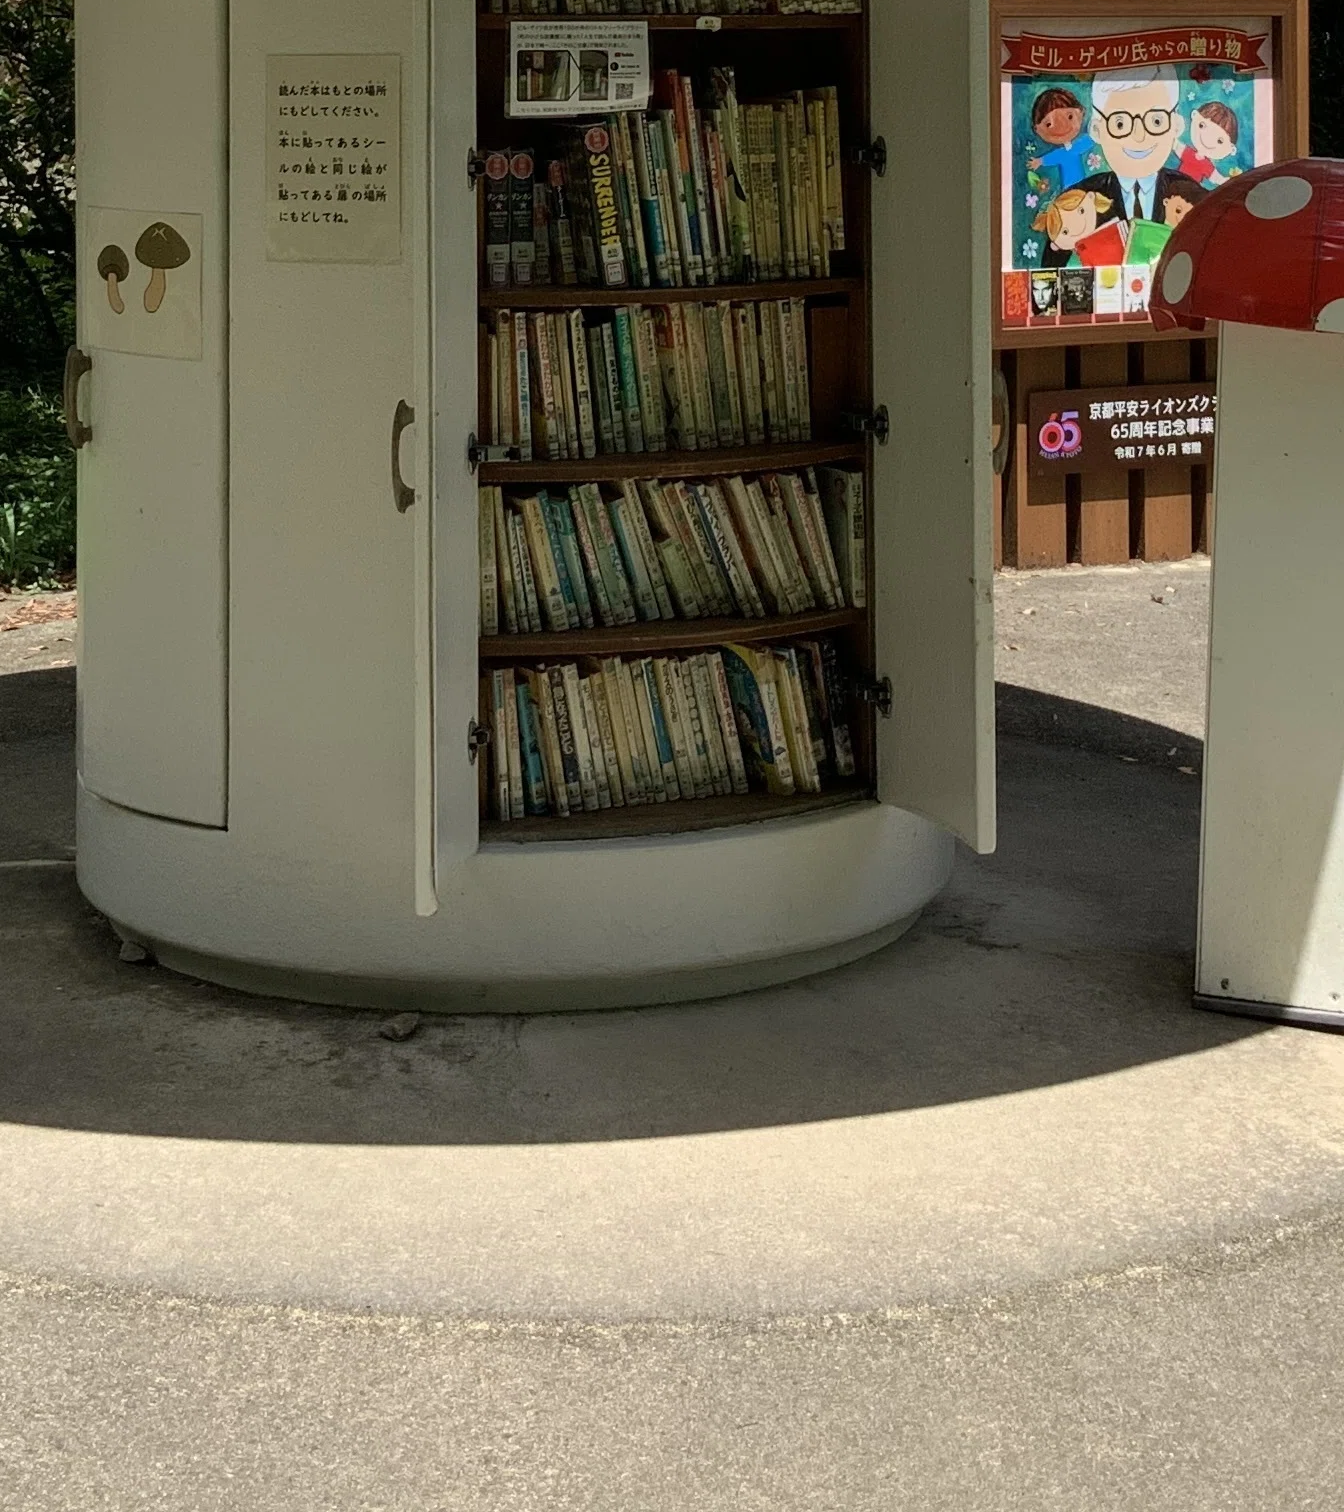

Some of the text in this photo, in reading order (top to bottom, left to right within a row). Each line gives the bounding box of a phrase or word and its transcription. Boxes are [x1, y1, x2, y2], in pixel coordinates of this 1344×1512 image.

[1029, 36, 1242, 67] ビル・ゲイツ氏からの贈り物
[279, 85, 387, 97] 読んだ本はもとの場所
[279, 105, 379, 118] にもどしてください。
[278, 137, 387, 148] 本に貼ってあるシー
[279, 163, 387, 175] ルの絵と同じ絵が
[278, 189, 387, 202] 貼ってある扉の場所
[279, 211, 349, 223] にもどしてね。
[1110, 416, 1214, 439] 65周年記念事業
